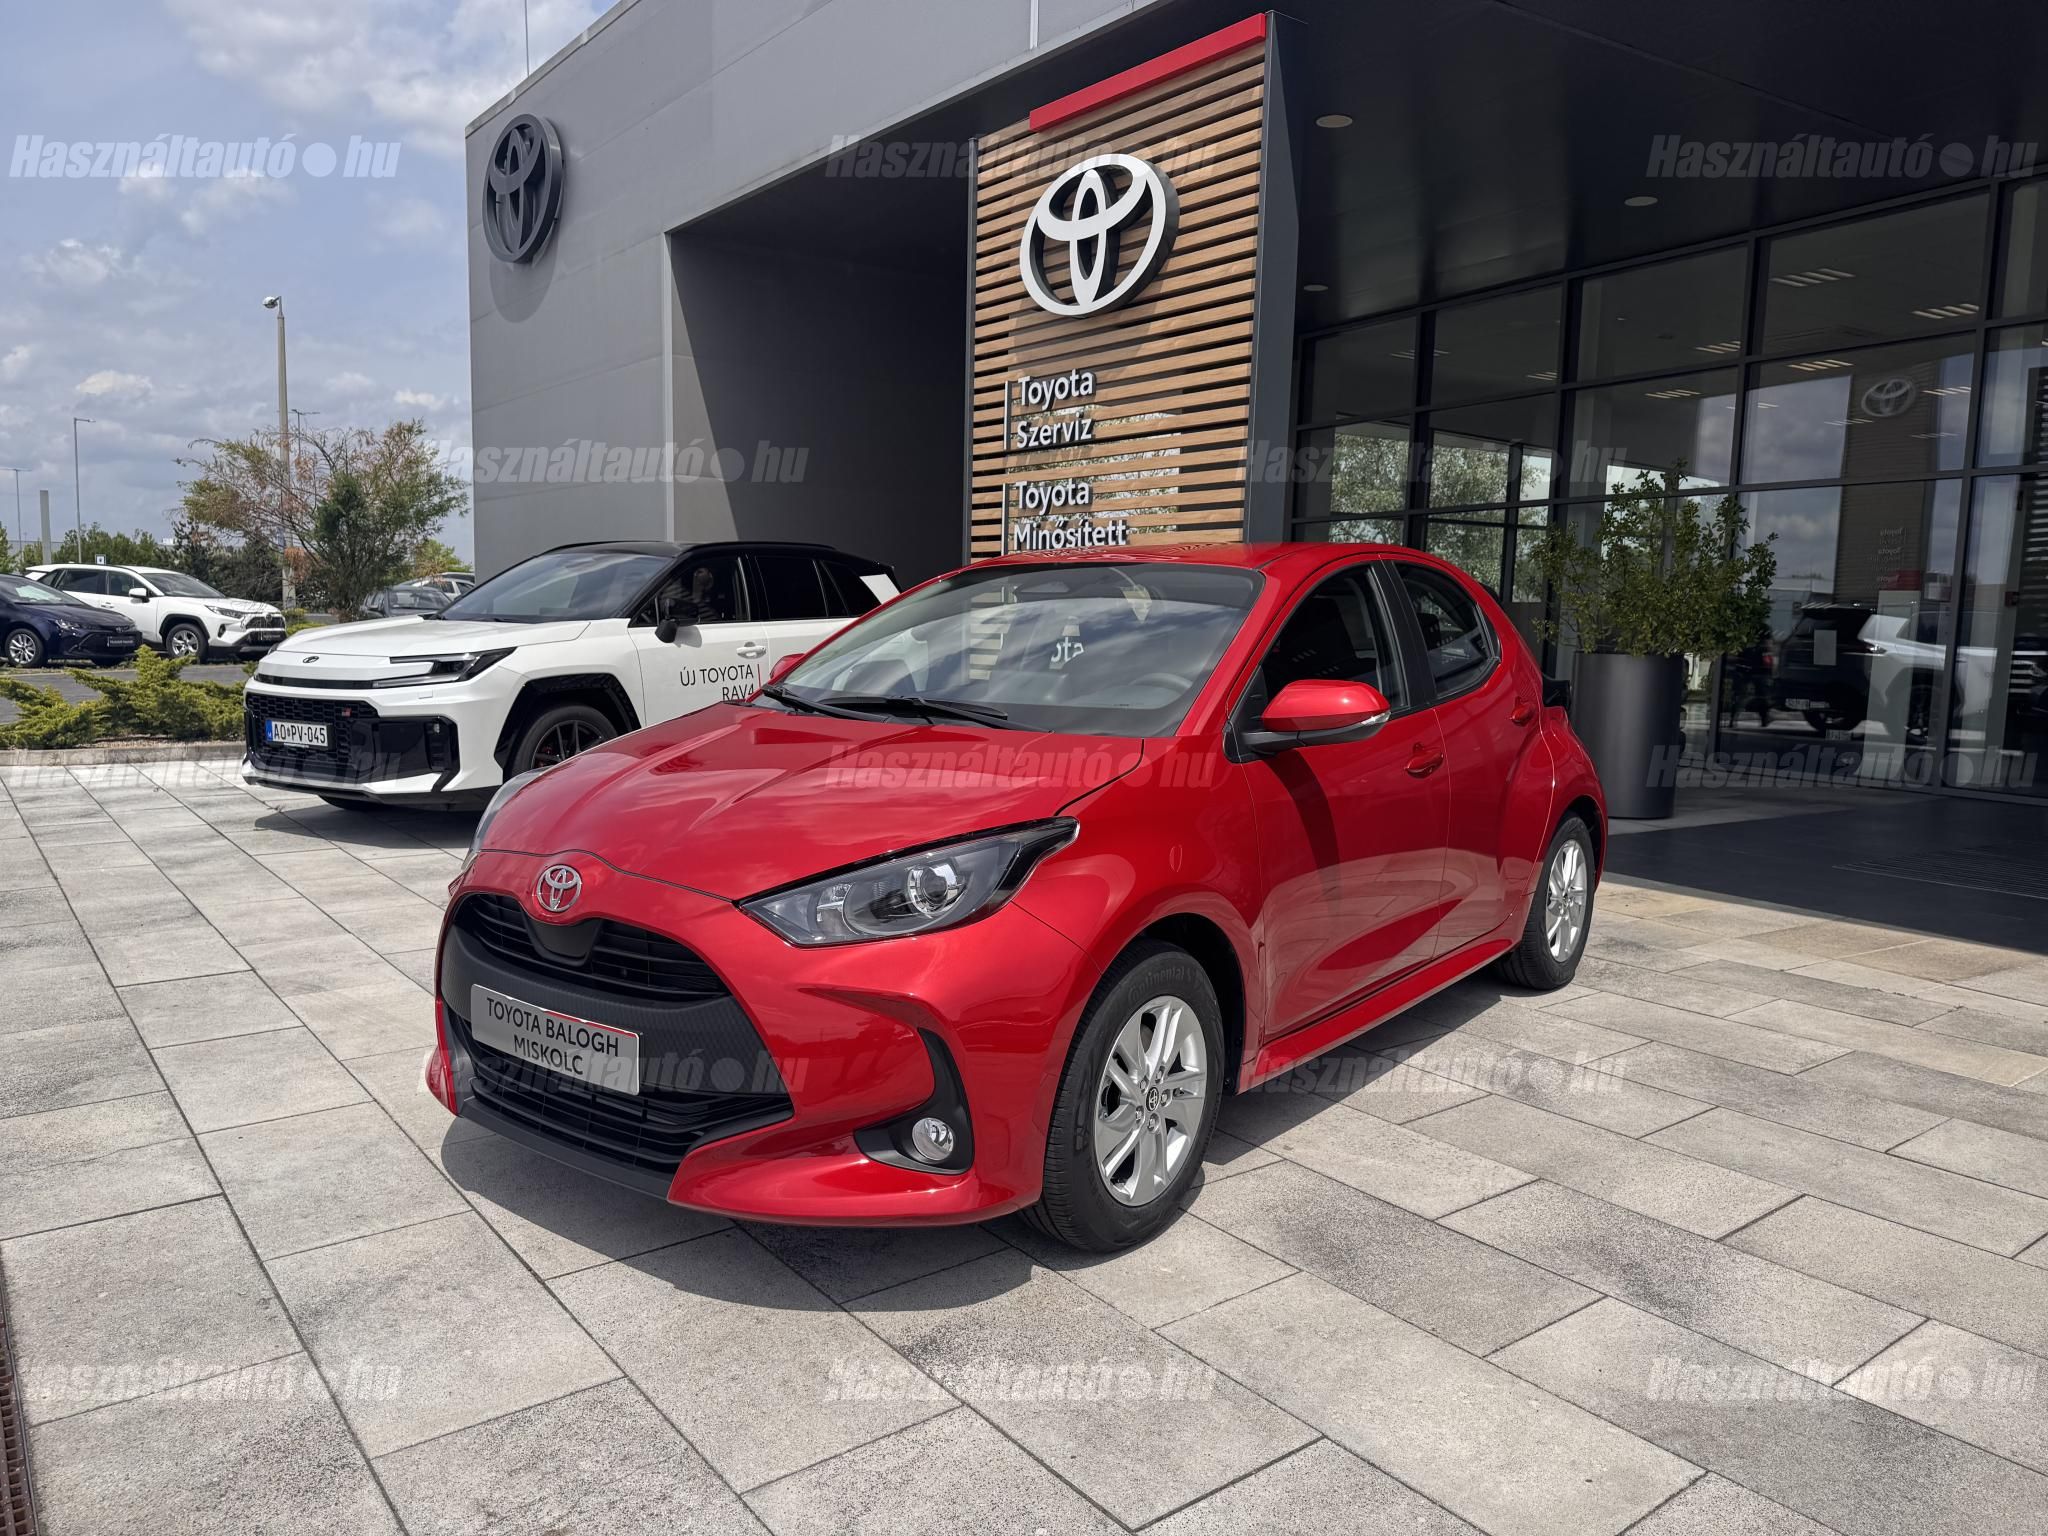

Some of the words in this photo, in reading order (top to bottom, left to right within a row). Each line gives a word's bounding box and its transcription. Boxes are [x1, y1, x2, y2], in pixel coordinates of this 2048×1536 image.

[1017, 368, 1096, 411] Toyota
[1016, 412, 1095, 449] Szerviz
[1015, 478, 1092, 516] Toyota
[1013, 518, 1129, 551] Minősített
[680, 666, 696, 686] ÚJ
[699, 664, 754, 684] TOYOTA
[722, 683, 755, 701] RAV4
[487, 997, 541, 1035] TOYOTA
[545, 1018, 619, 1057] BALOGH
[513, 1034, 583, 1075] MISKOLC
